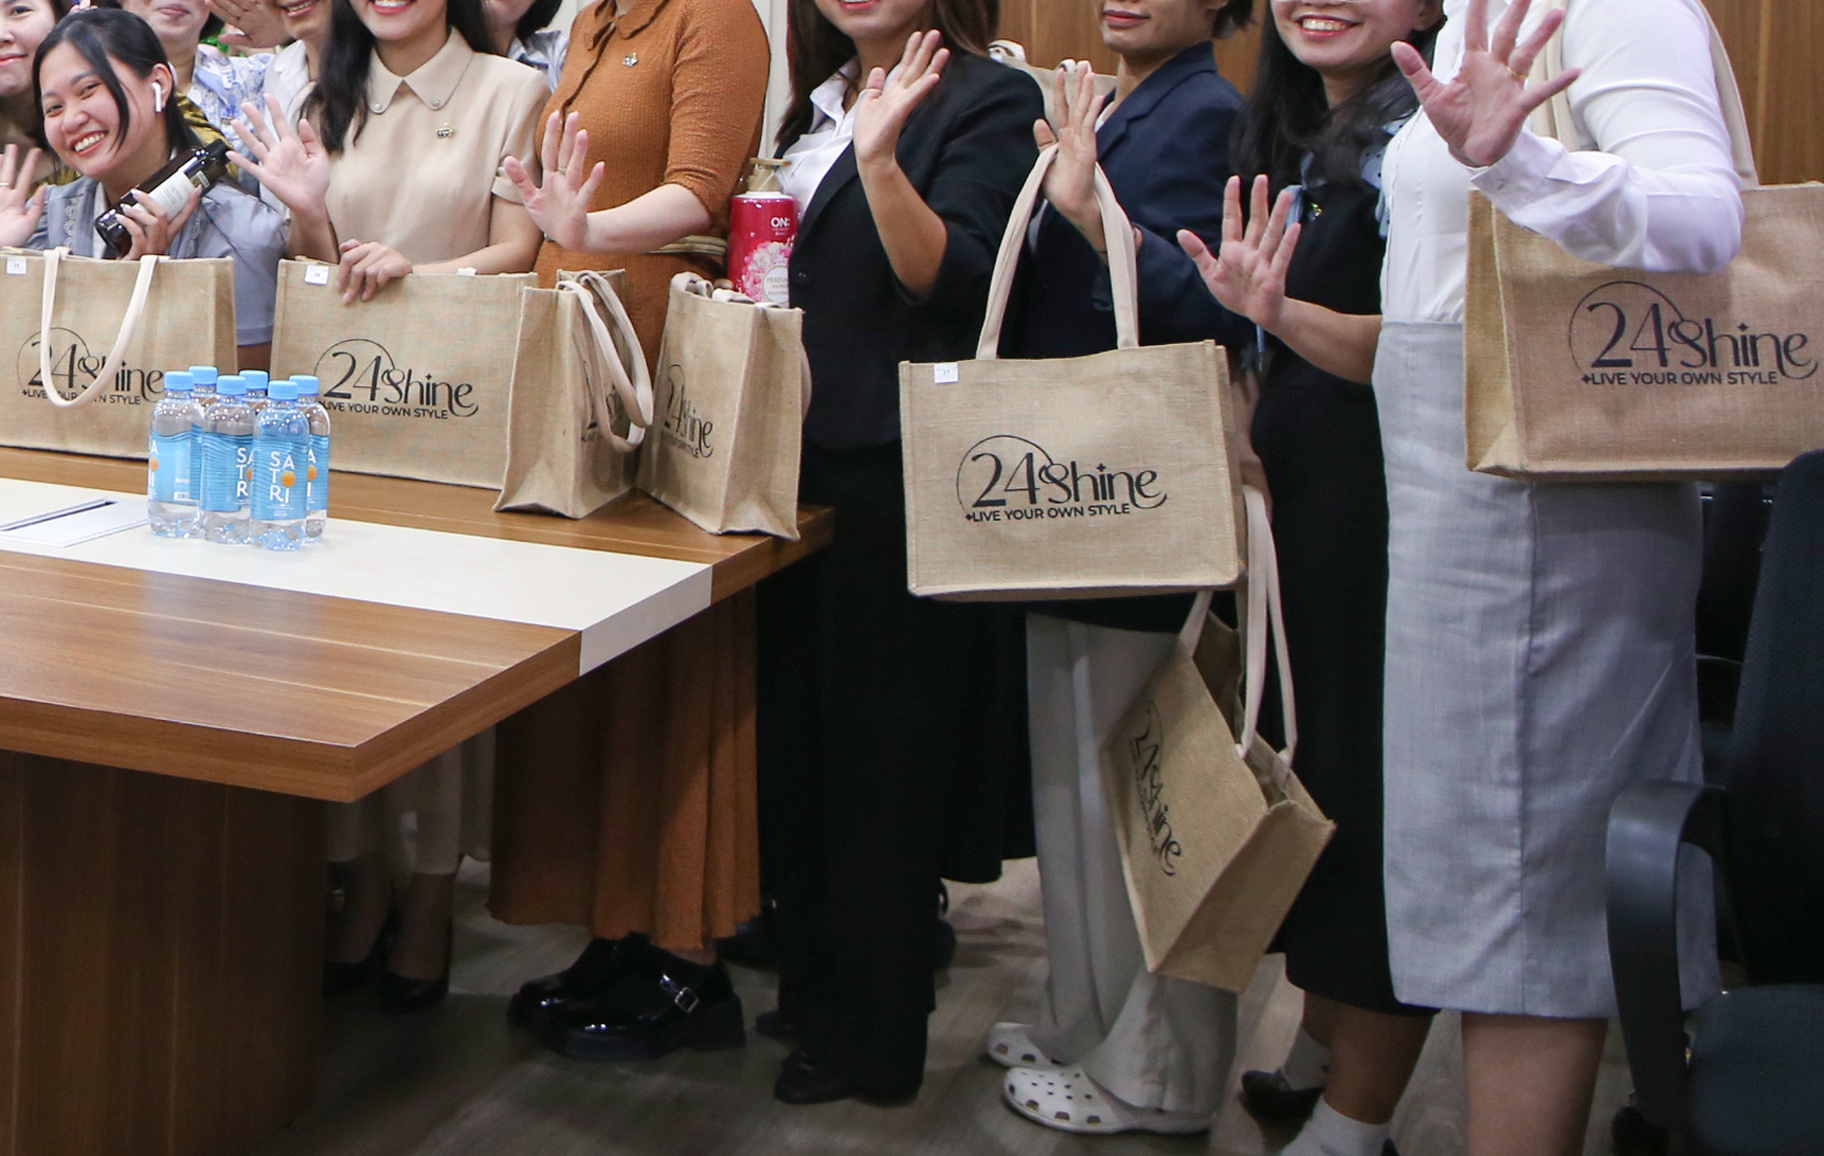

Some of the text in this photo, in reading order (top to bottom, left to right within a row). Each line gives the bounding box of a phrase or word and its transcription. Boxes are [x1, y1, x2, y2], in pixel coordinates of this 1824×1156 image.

[1587, 302, 1818, 380] 24Shine
[324, 351, 479, 417] 24Shine
[1591, 370, 1779, 385] LIVE YOUR OWN STYLE
[109, 394, 141, 405] STYLE
[348, 402, 379, 414] YOUR
[382, 406, 411, 417] OWN
[414, 408, 449, 420] STYLE
[971, 452, 1167, 509] 24Shine
[270, 485, 290, 504] RI
[972, 502, 1131, 523] LIVE YOUR OWN STYLE
